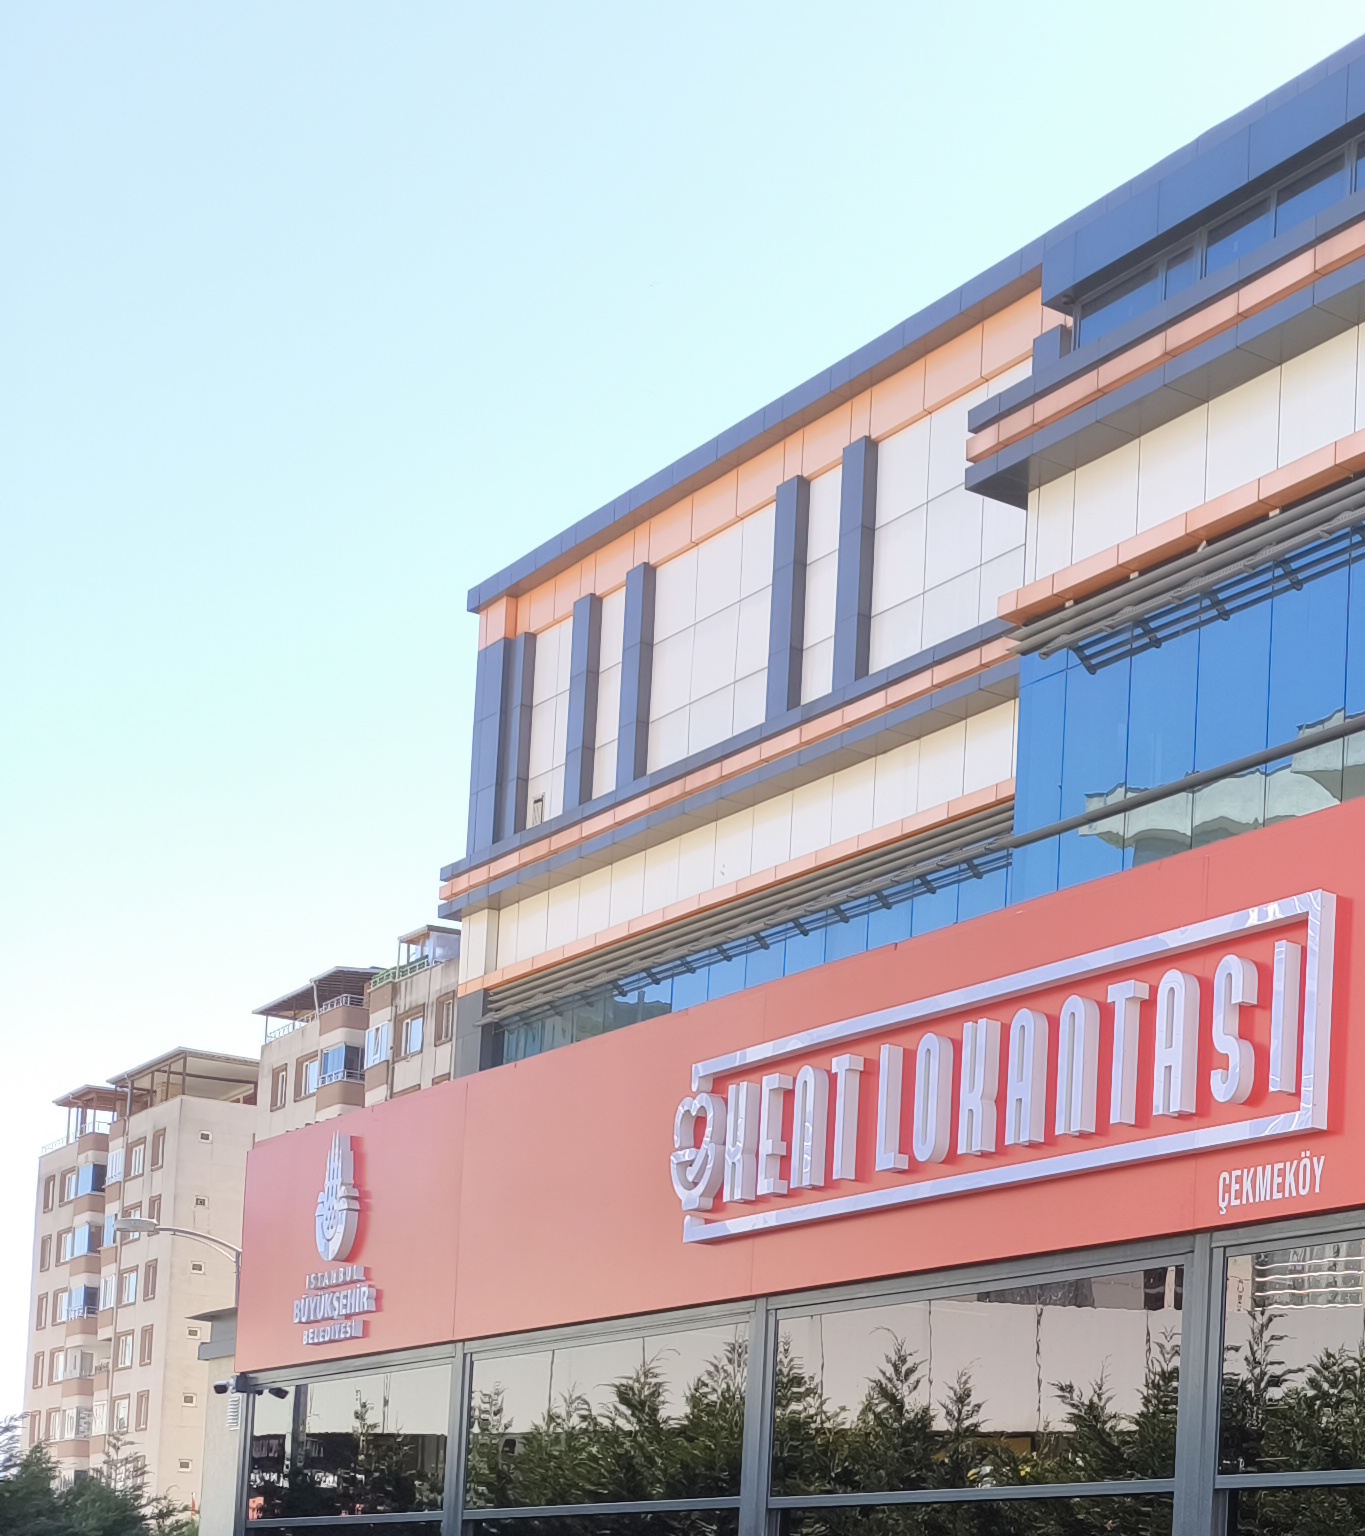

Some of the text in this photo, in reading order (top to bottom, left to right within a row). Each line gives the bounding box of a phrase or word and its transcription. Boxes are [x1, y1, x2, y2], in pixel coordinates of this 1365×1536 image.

[722, 939, 1303, 1204] KENT LOKANTASI
[1217, 1155, 1326, 1215] ÇEKMEKÖY
[293, 1283, 376, 1324] BÜYÜKŞEHİR
[303, 1319, 364, 1345] BELEDİYESİ
